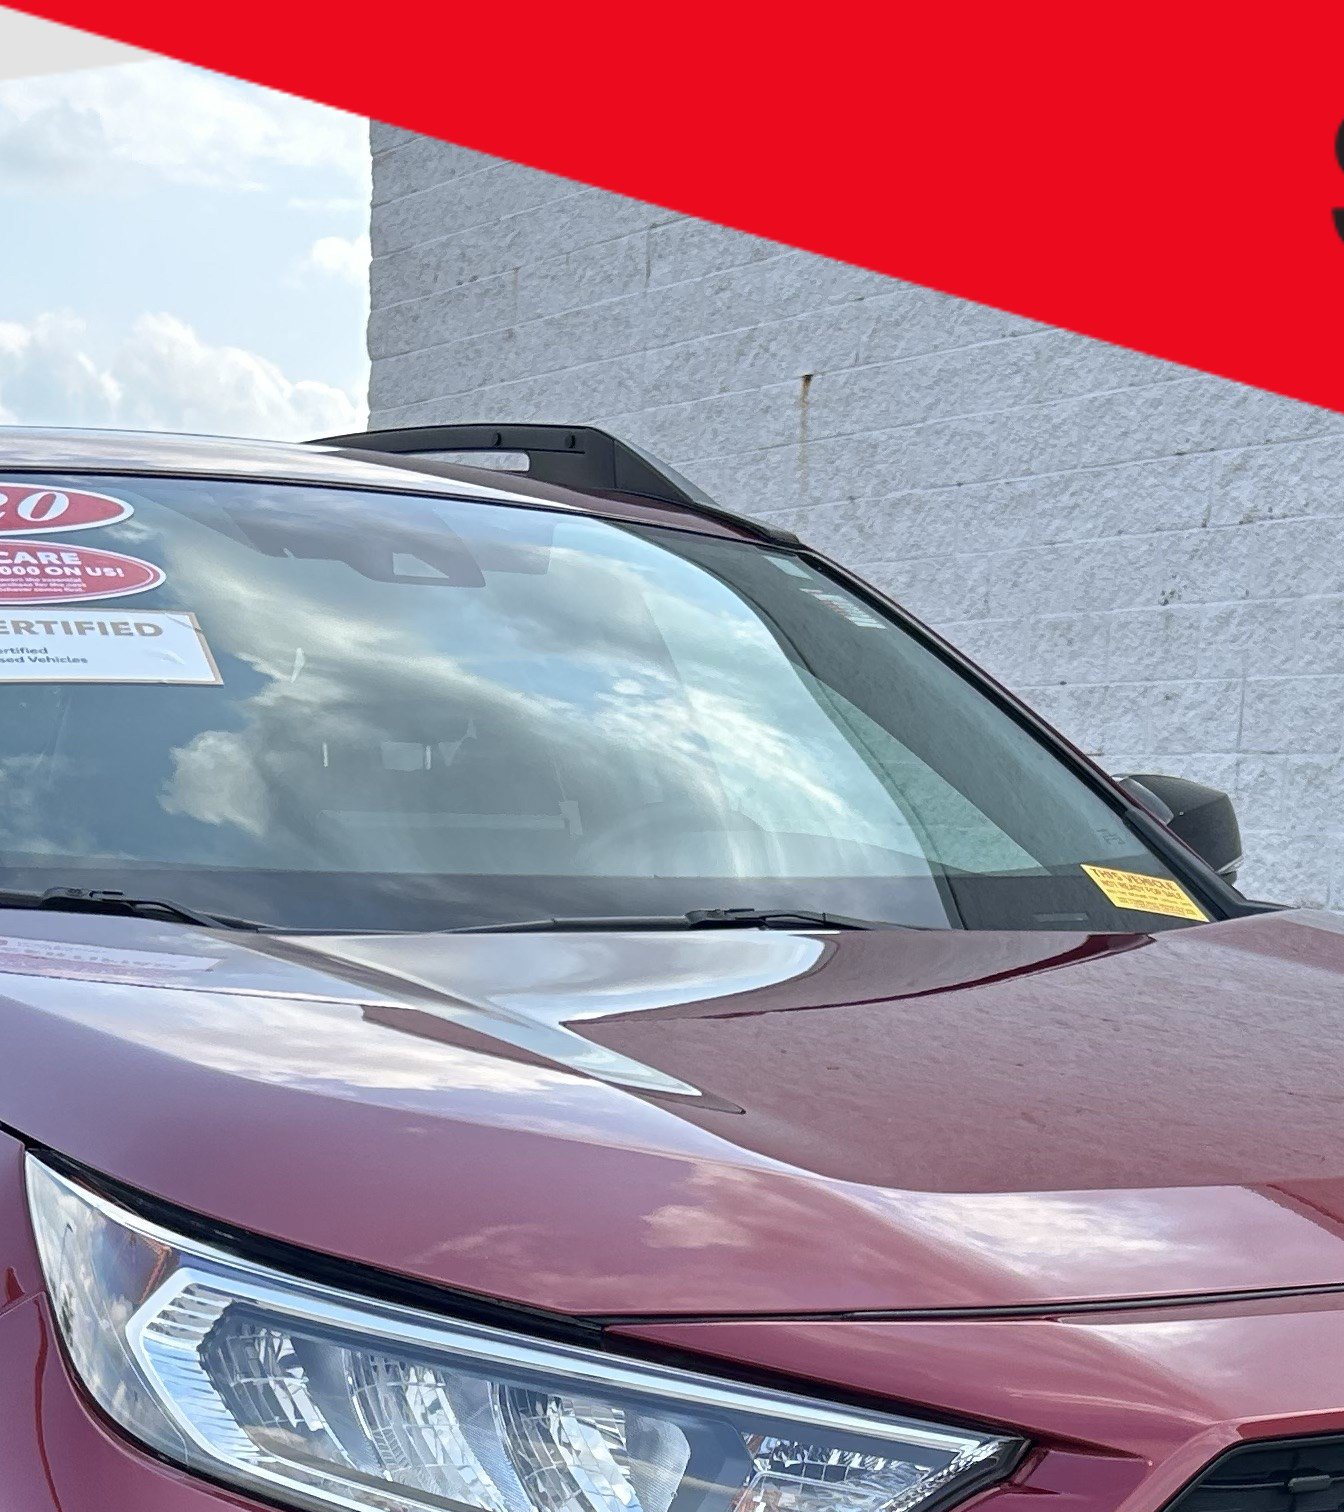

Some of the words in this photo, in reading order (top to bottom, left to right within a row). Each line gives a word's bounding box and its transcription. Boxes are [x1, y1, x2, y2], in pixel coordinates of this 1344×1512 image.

[44, 566, 82, 576] ON
[84, 566, 125, 578] US!
[27, 655, 89, 665] Vehicles
